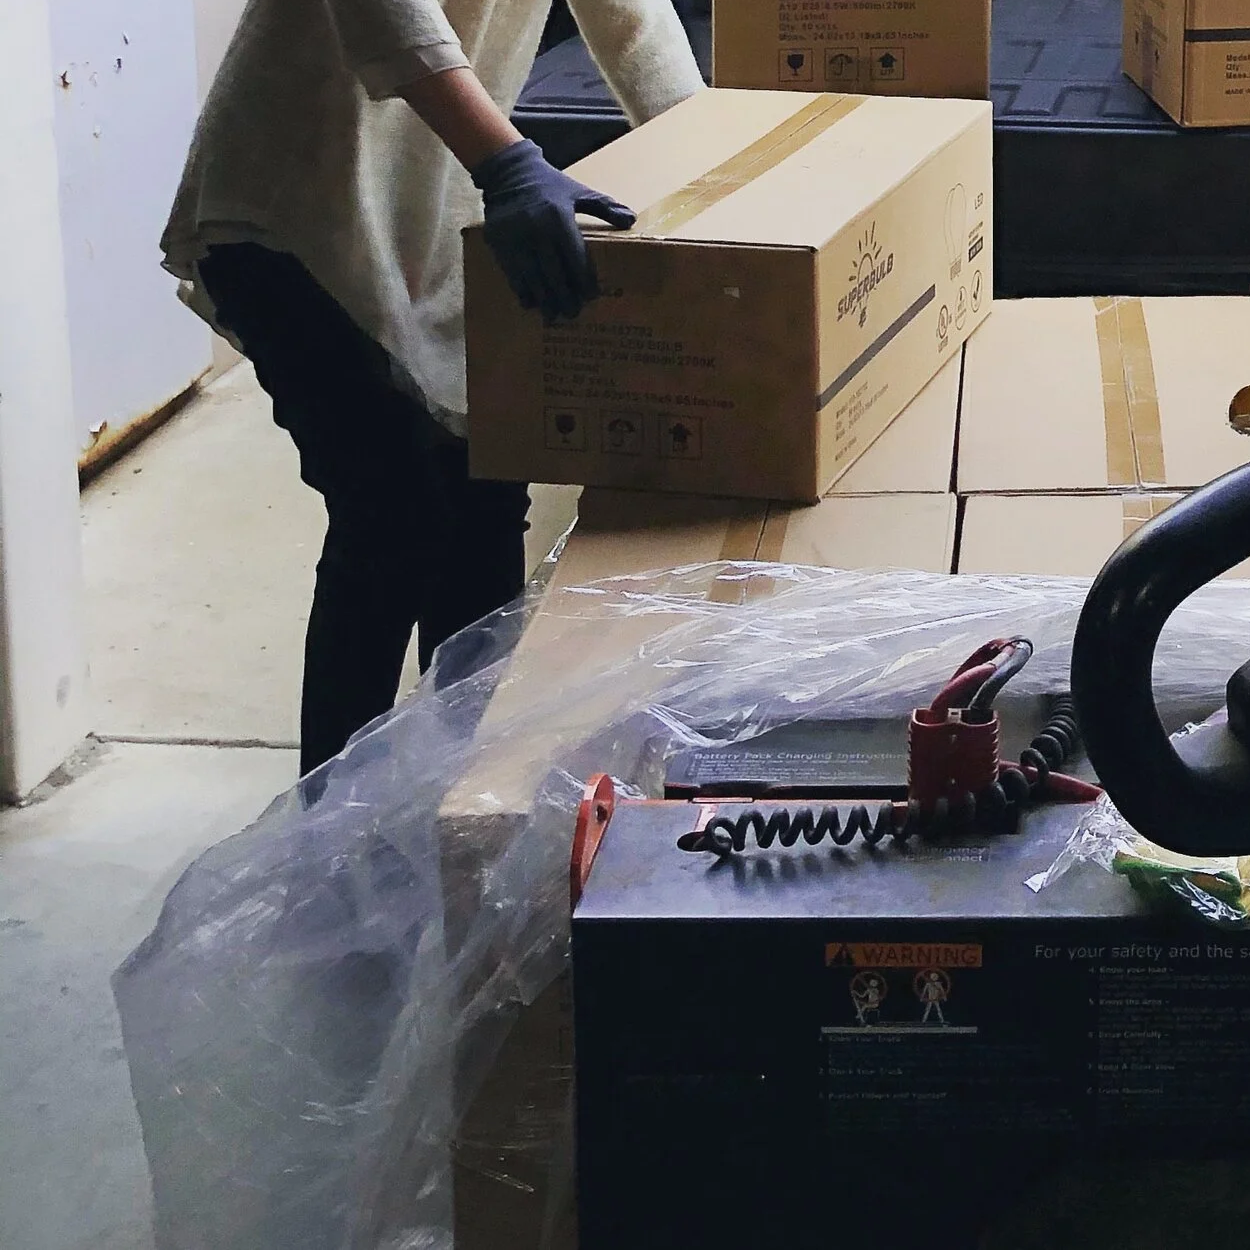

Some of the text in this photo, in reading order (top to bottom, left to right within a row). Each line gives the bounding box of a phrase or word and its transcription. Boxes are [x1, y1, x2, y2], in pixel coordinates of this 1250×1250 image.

[974, 192, 984, 210] LED
[836, 253, 894, 323] SUPERBULB
[694, 752, 906, 762] Battery Pack Charging Instruction
[861, 946, 978, 965] WARNING
[1035, 945, 1060, 959] For
[1067, 946, 1106, 961] your
[1111, 944, 1162, 962] safety
[1169, 944, 1200, 959] and
[1206, 944, 1234, 959] the
